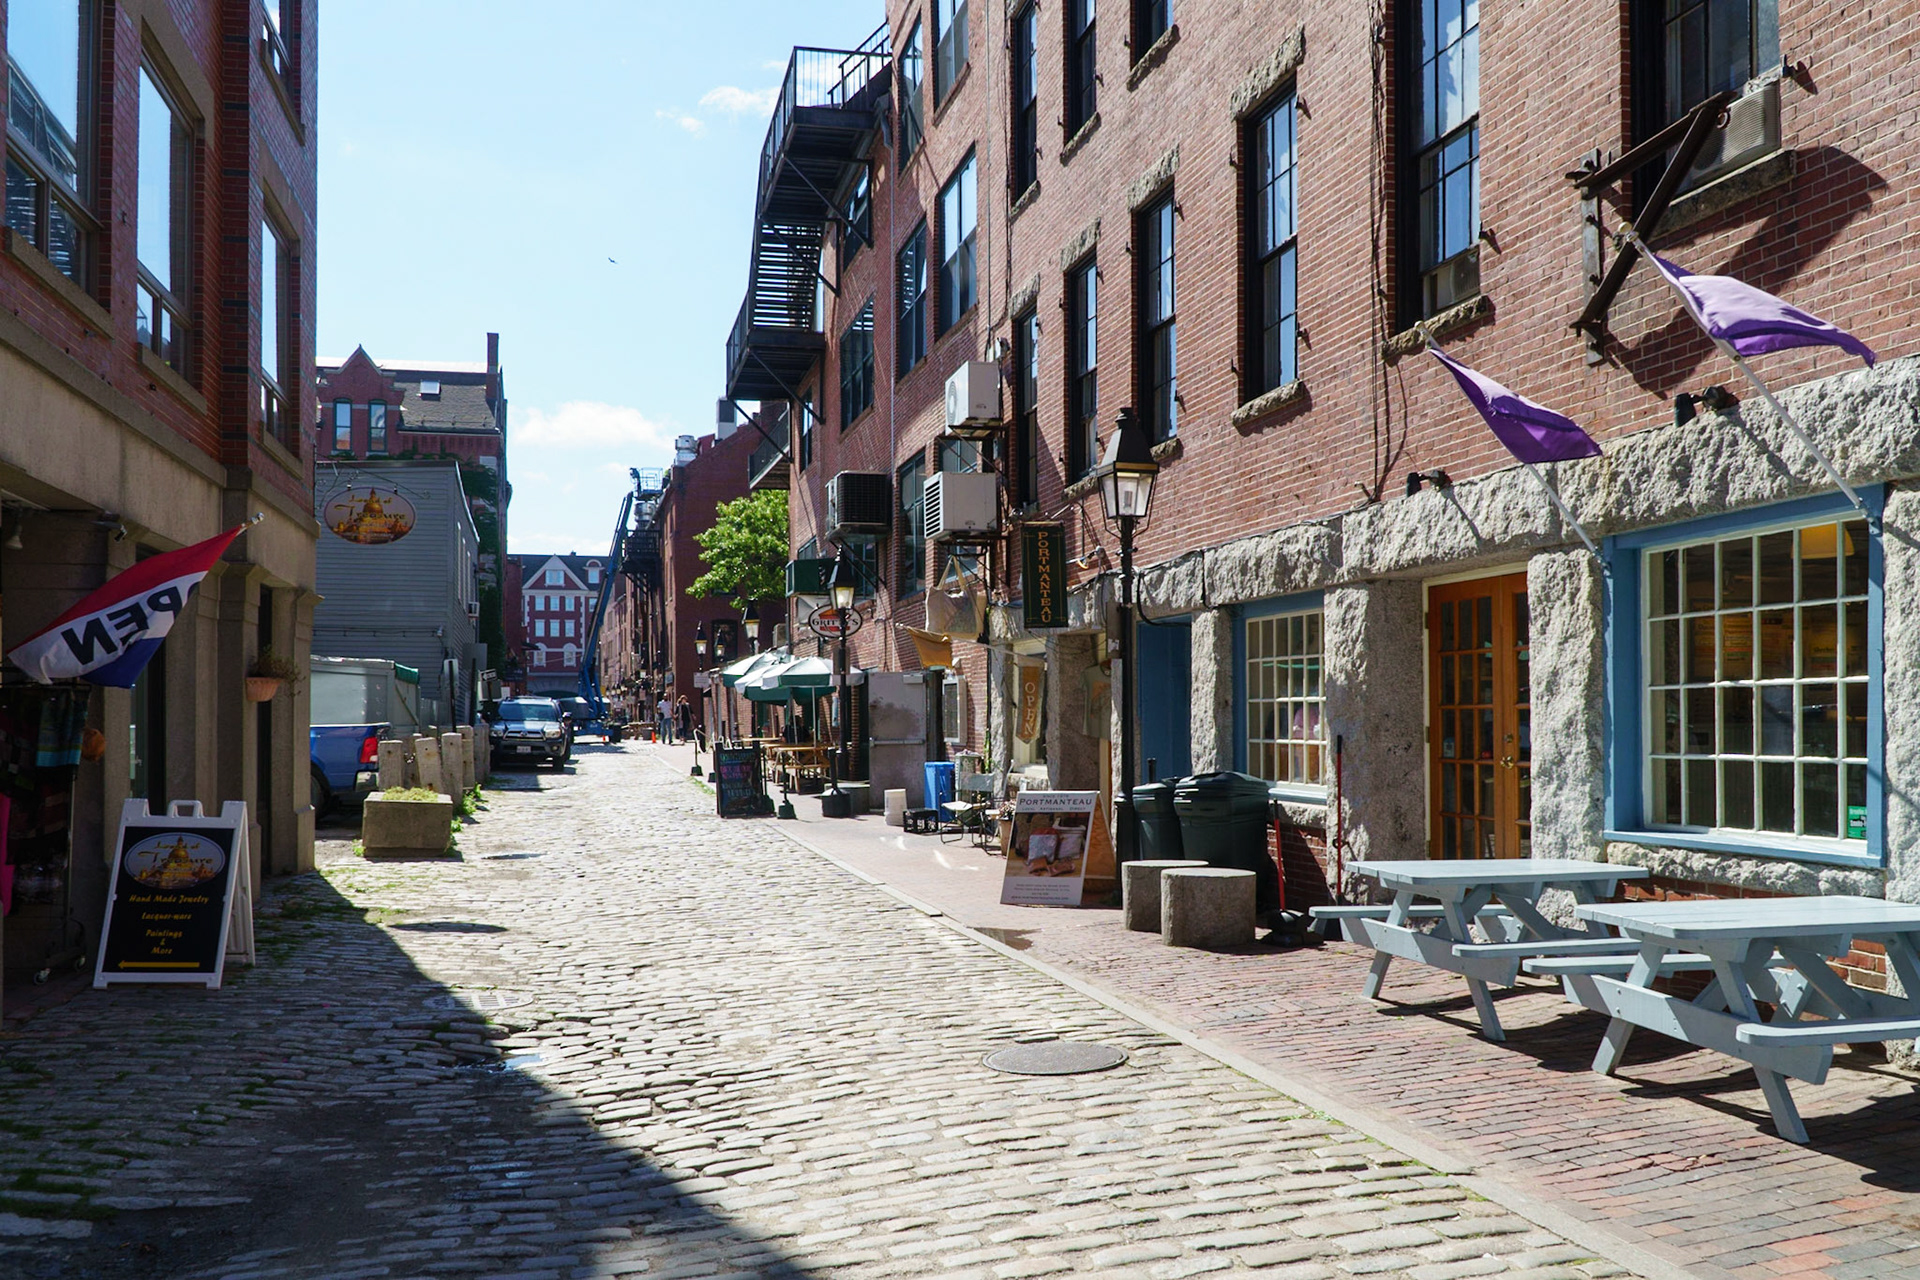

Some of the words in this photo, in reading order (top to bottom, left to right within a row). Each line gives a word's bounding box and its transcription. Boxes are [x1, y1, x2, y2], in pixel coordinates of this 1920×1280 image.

[1037, 531, 1052, 623] PORTMANTEAU
[1024, 682, 1037, 735] OPEN
[1019, 798, 1092, 806] PORTMANTEAU
[129, 894, 151, 903] Hand
[153, 894, 177, 903] Made
[179, 894, 209, 904] Jewelry
[145, 929, 183, 938] Paintings
[151, 946, 173, 955] More
